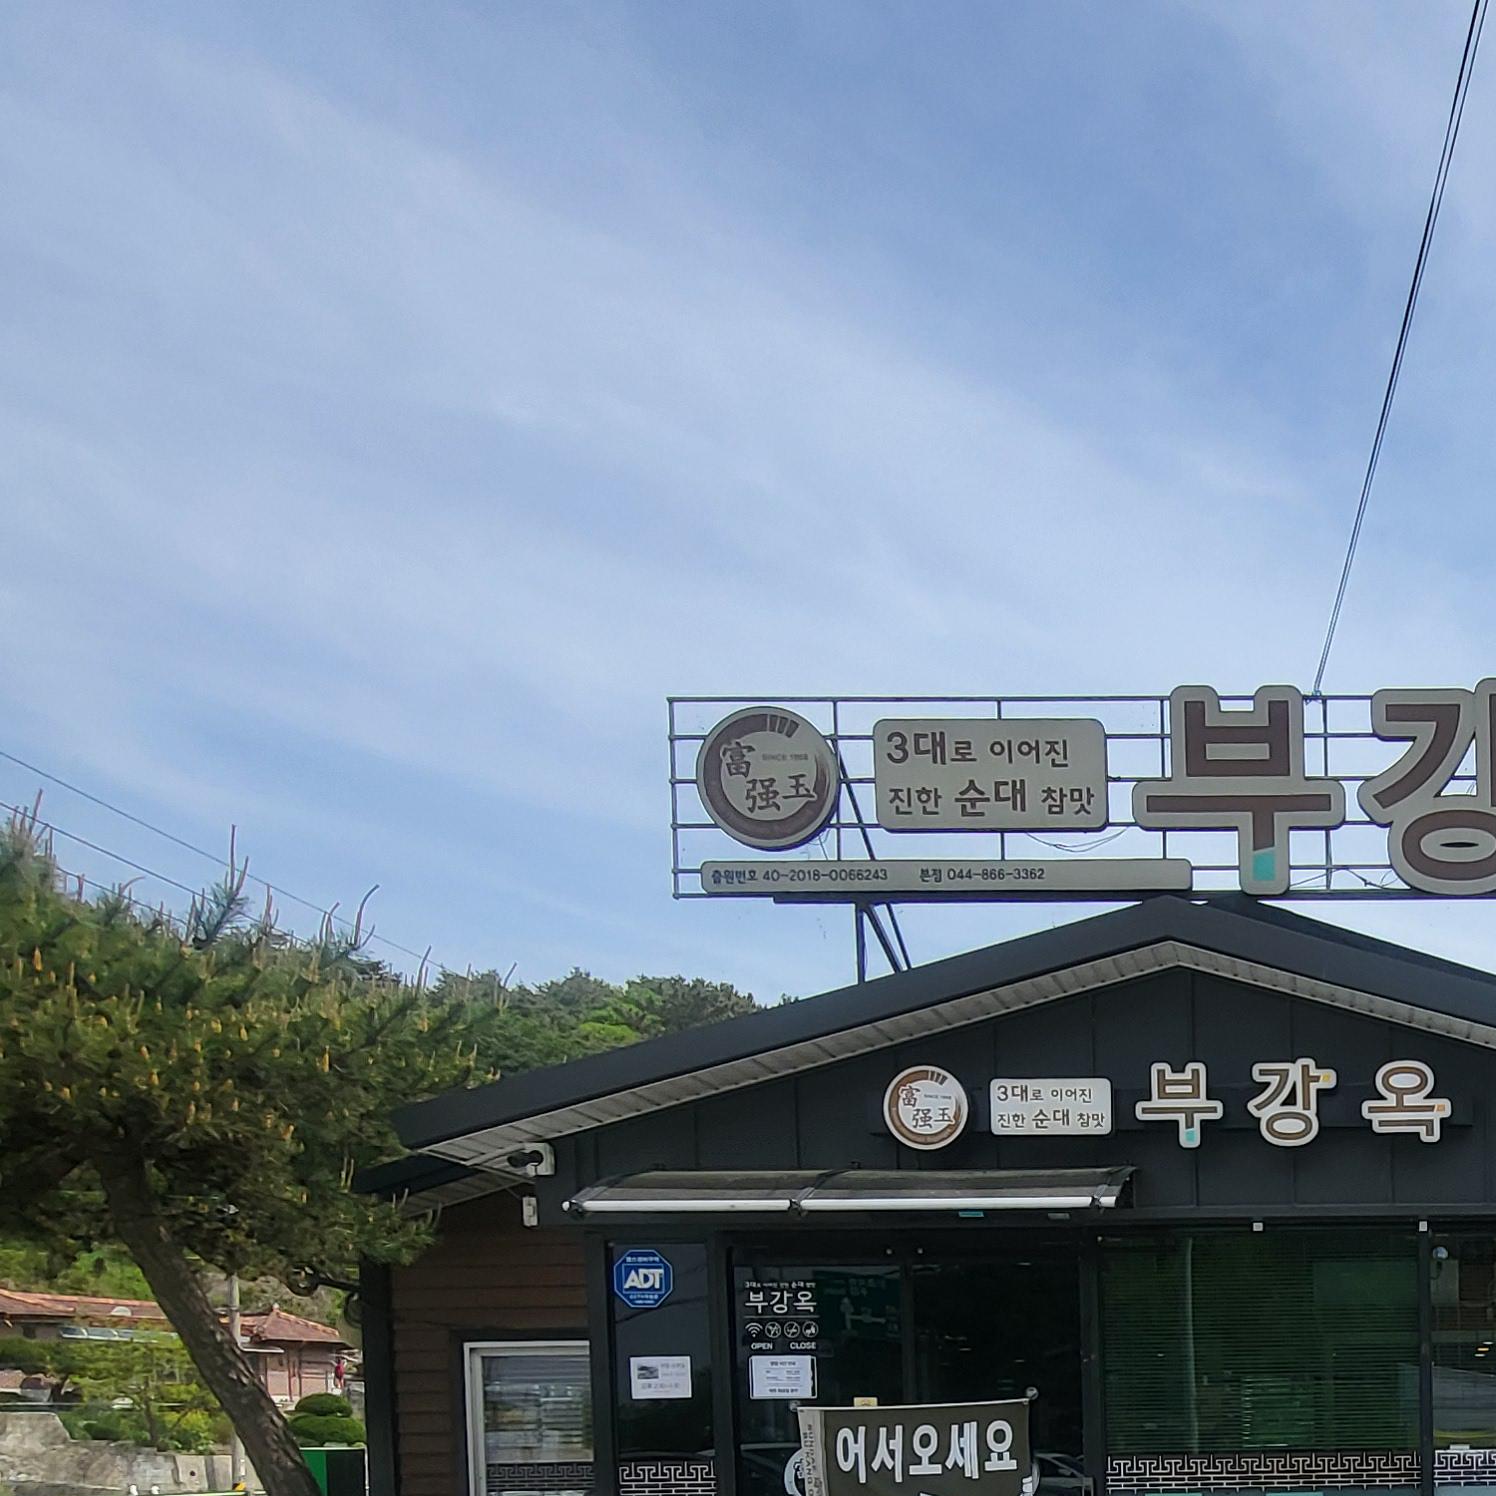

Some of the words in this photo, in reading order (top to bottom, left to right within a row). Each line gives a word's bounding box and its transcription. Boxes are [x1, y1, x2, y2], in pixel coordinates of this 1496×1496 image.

[886, 731, 978, 765] 3대로
[989, 739, 1069, 768] 이어진
[888, 787, 943, 816] 진한
[954, 779, 1027, 818] 순대
[1040, 787, 1095, 816] 참맛
[762, 868, 888, 882] 40-2018-0066243
[919, 868, 943, 883] 본점
[946, 867, 1045, 881] 044-866-3362
[996, 1084, 1044, 1103] 3대로
[1050, 1088, 1092, 1104] 이어진
[1139, 1061, 1448, 1145] 부강옥
[997, 1112, 1027, 1129] 진한
[1031, 1108, 1070, 1129] 순대
[1076, 1112, 1106, 1128] 참맛
[623, 1268, 664, 1289] ADT
[744, 1290, 817, 1314] 부강옥
[750, 1342, 773, 1350] OPEN
[789, 1341, 817, 1350] CLOSE
[836, 1419, 1018, 1484] 어서오세요
